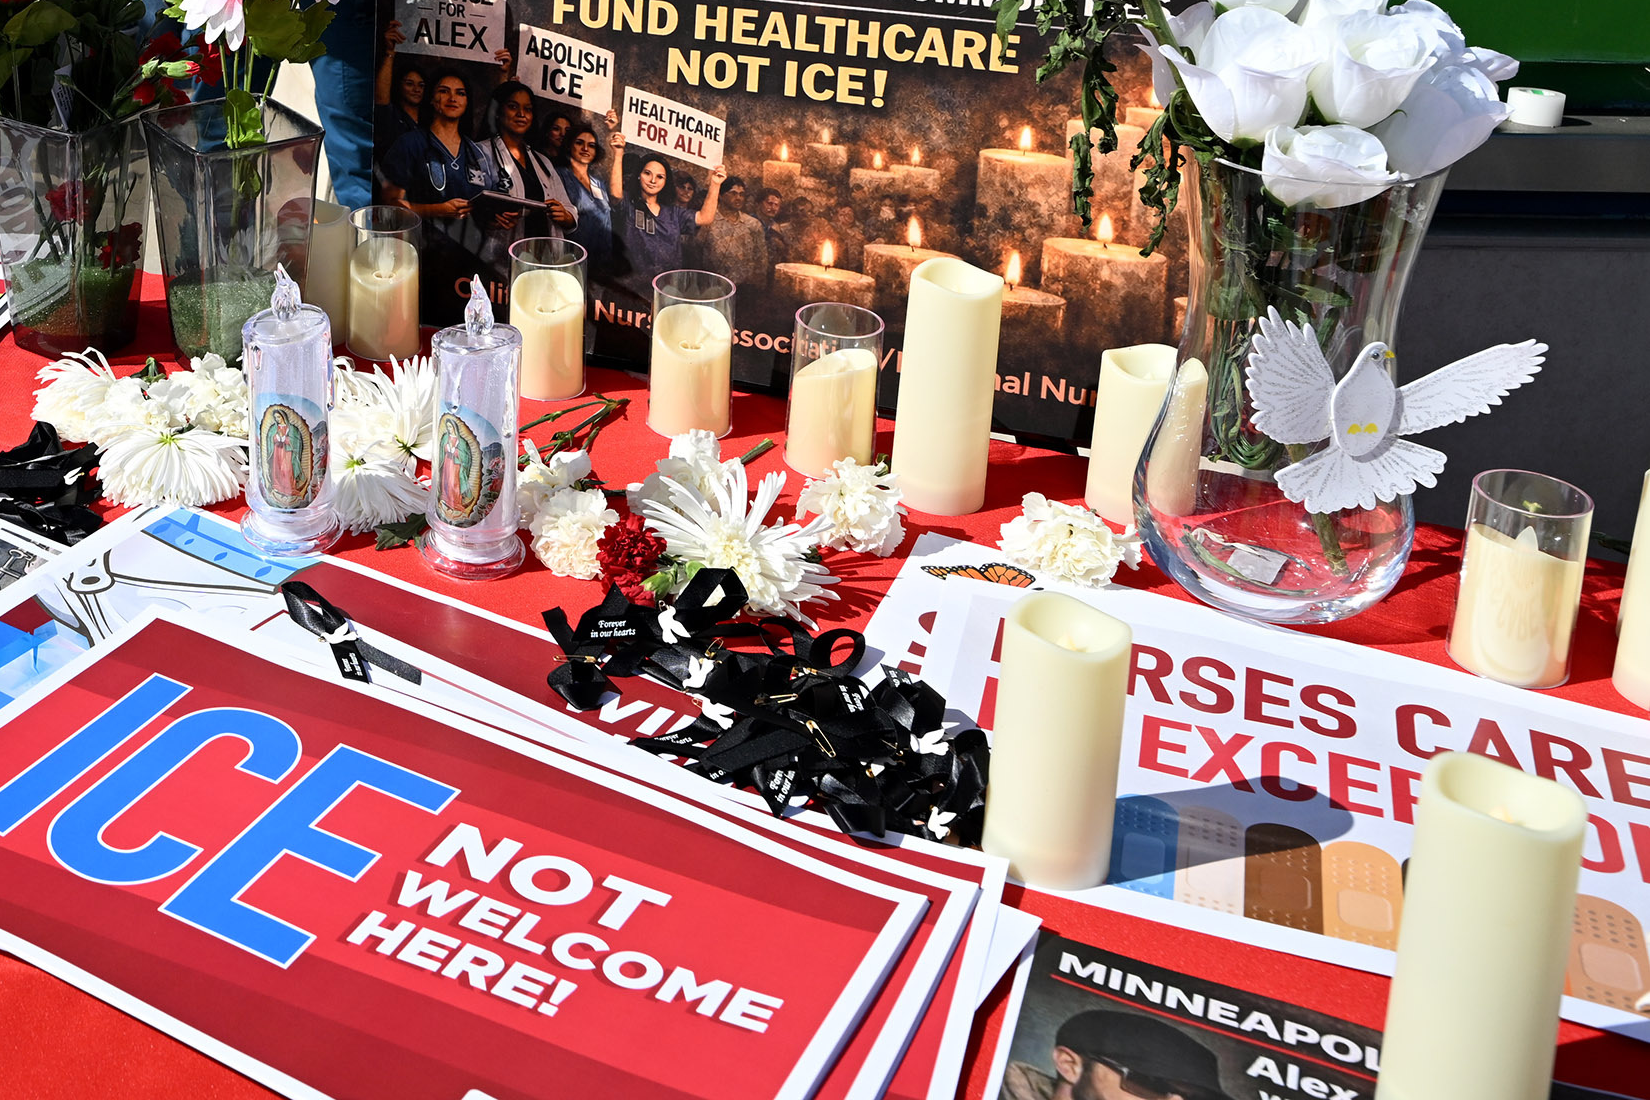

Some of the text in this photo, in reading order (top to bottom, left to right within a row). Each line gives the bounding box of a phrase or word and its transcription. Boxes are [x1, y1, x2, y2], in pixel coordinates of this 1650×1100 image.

[438, 1, 465, 19] FOR
[413, 18, 489, 53] ALEX
[525, 34, 608, 78] ABOLISH
[694, 6, 1021, 76] HEALTHCARE
[541, 65, 584, 99] ICE
[665, 47, 888, 109] NOT ICE!
[629, 96, 721, 143] HEALTHCARE
[636, 120, 707, 160] FOR ALL
[590, 627, 636, 638] in our hearts
[598, 619, 627, 629] Forever
[425, 822, 673, 931] NOT
[345, 910, 578, 1018] HERE!
[395, 870, 785, 1034] WELCOME
[1246, 1055, 1359, 1100] Alex
